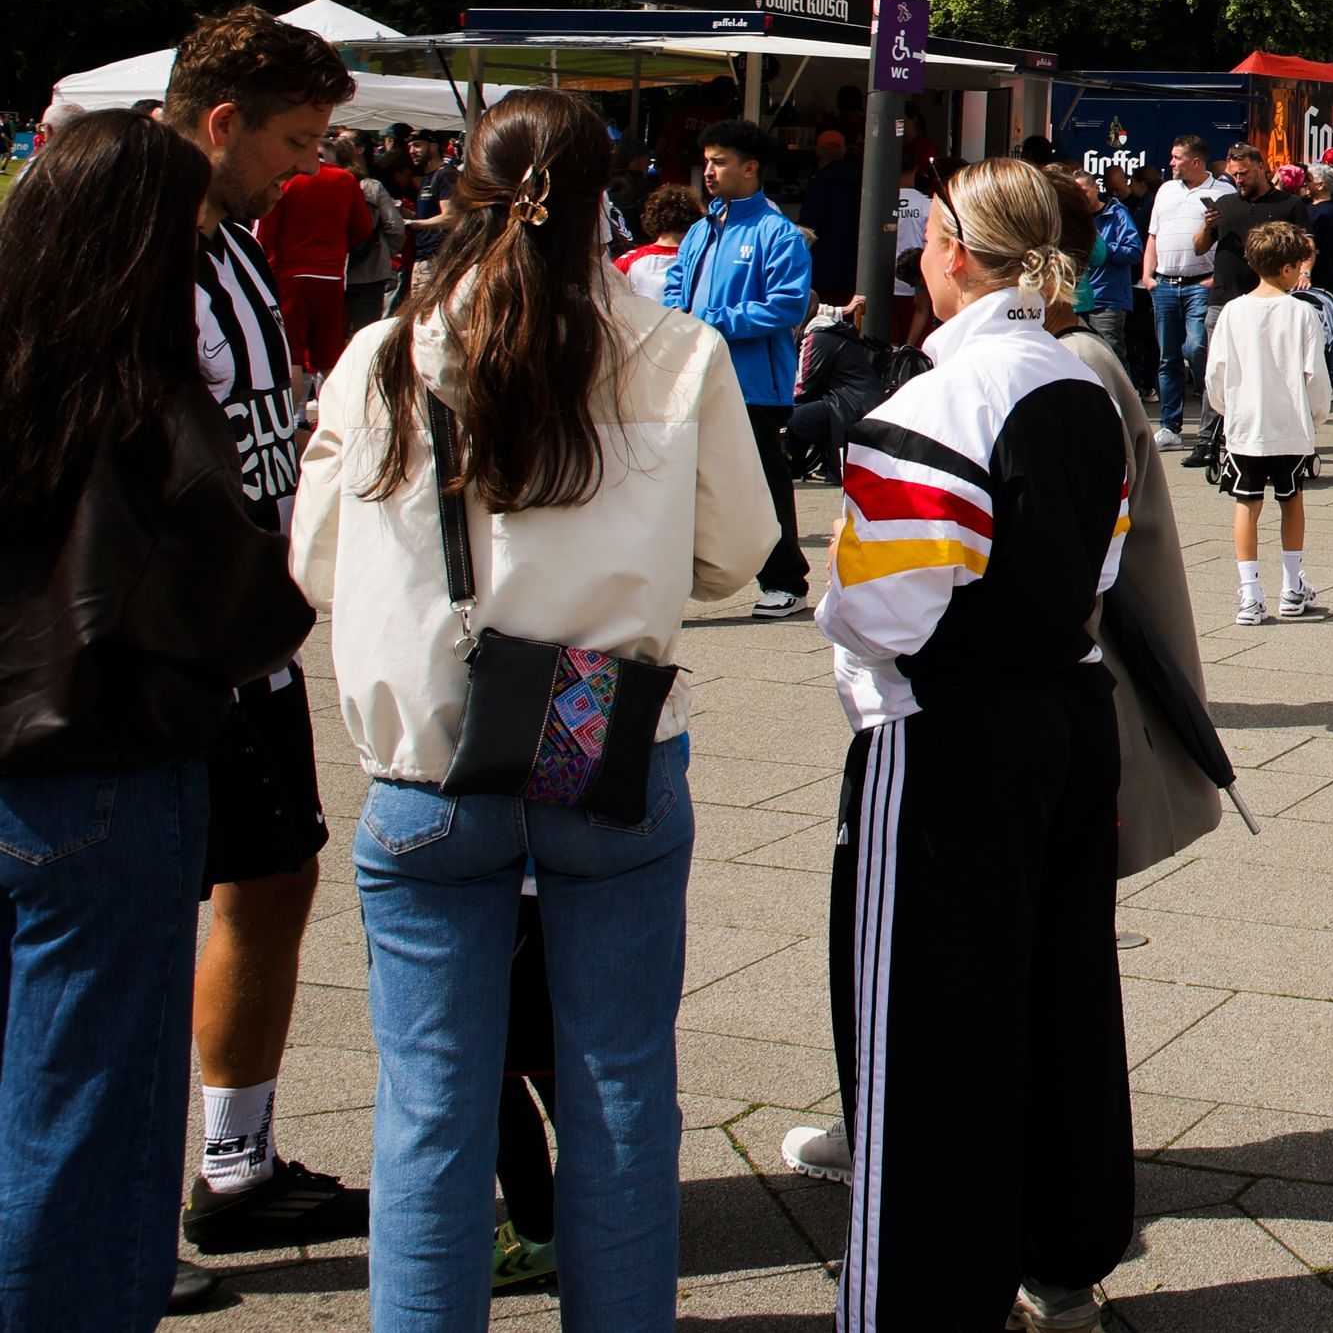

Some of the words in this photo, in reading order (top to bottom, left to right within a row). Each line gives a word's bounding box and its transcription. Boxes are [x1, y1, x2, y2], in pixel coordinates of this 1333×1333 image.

[712, 19, 748, 29] gaffel.de
[890, 67, 909, 79] WC
[1084, 149, 1146, 175] Gaffel
